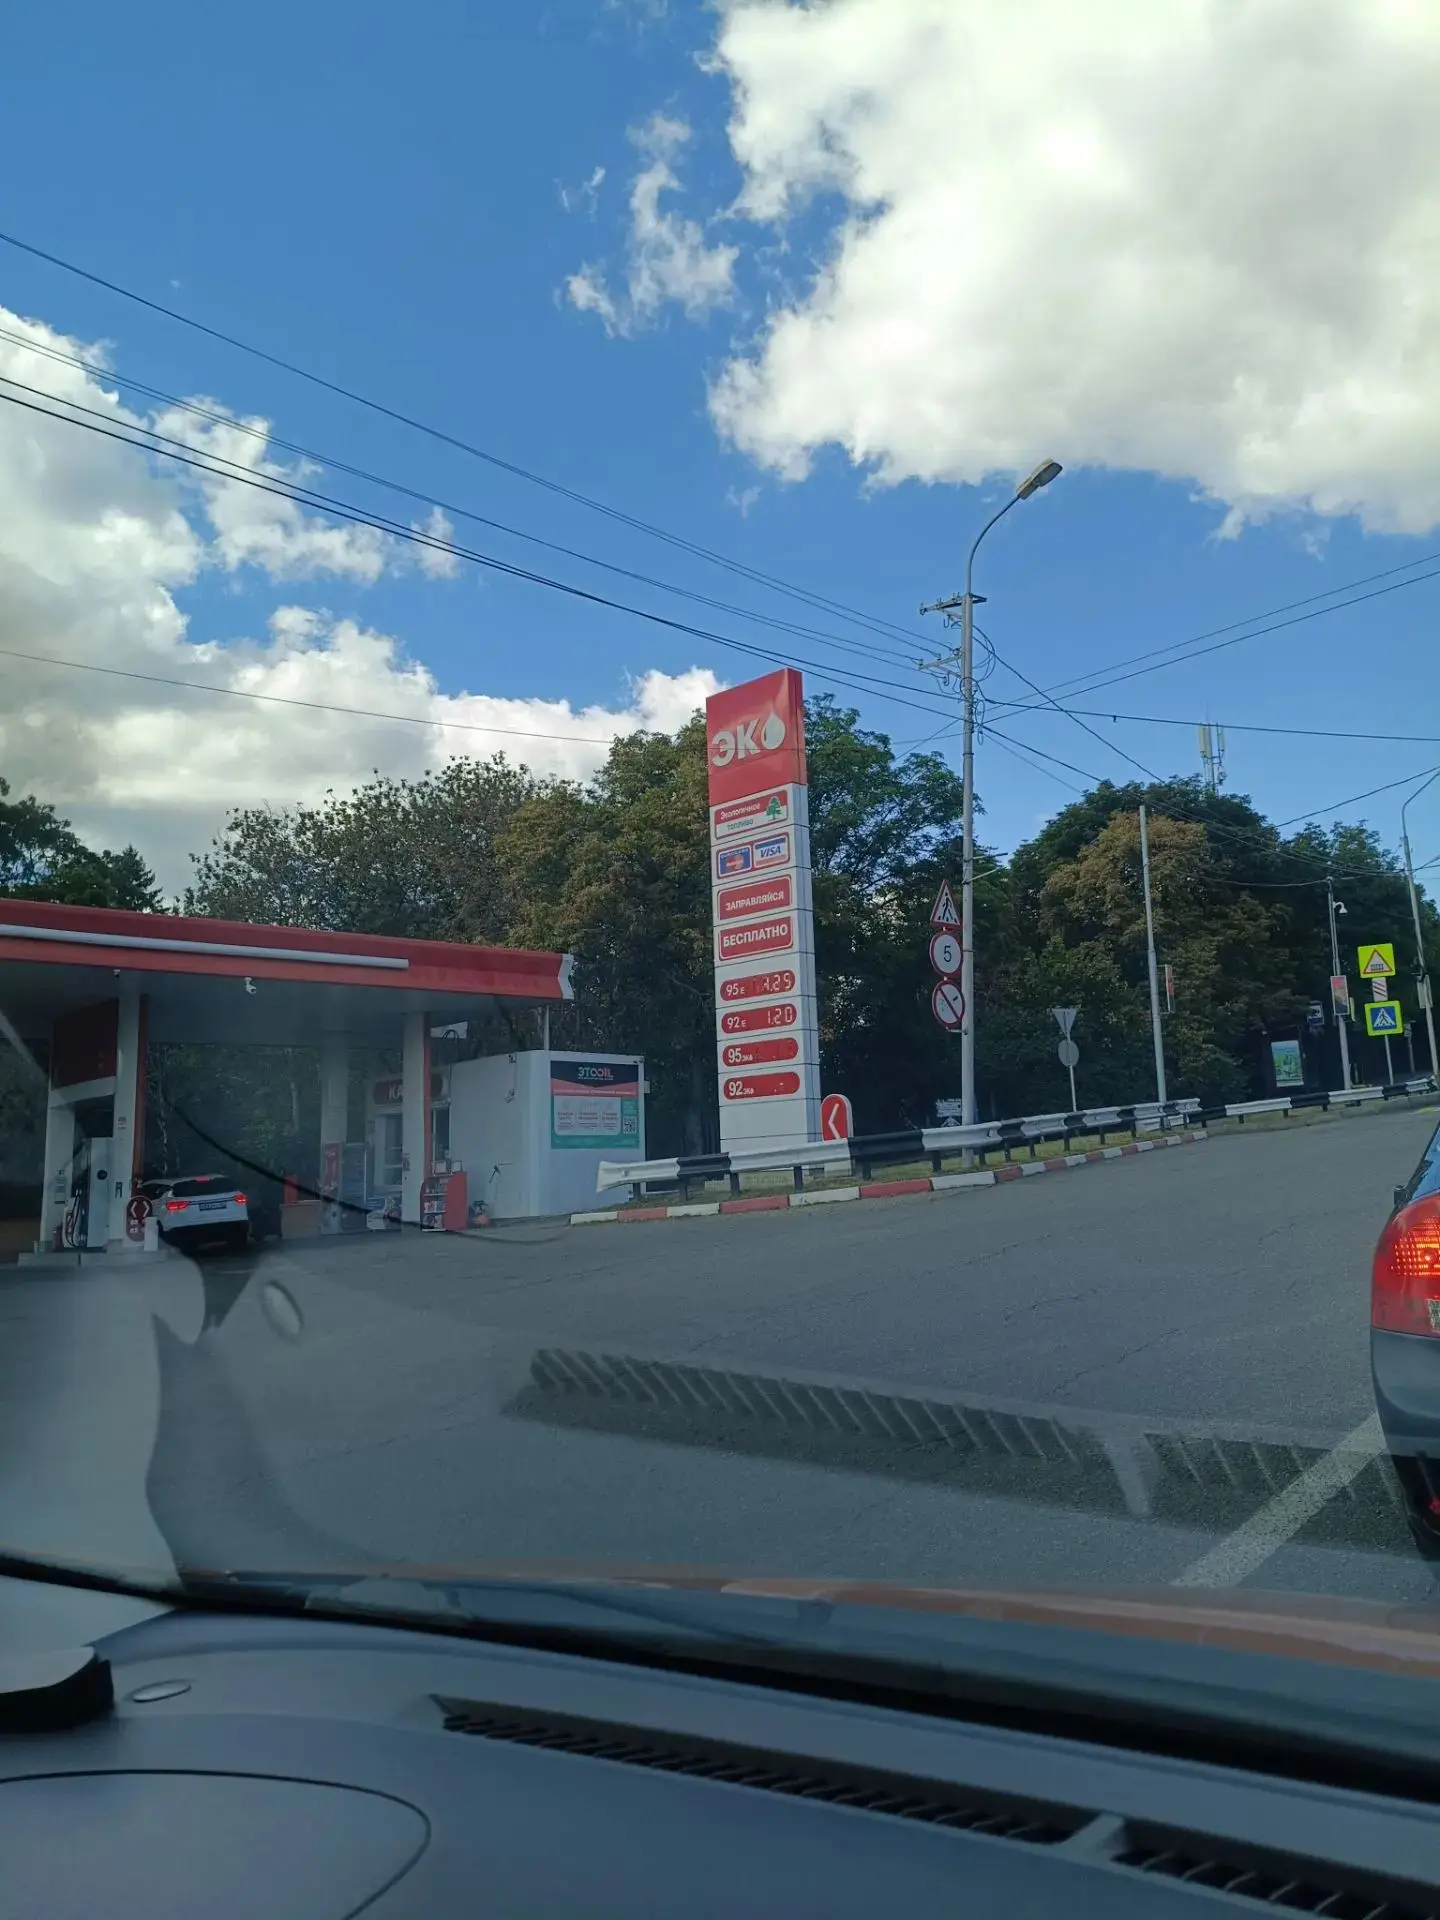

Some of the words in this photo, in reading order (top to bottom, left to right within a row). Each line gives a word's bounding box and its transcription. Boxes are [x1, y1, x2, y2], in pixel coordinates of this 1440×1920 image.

[760, 846, 781, 858] VISA
[726, 891, 784, 910] ЗАПРАВЛЯЙСЯ
[723, 924, 788, 947] БЕСПЛАТНО
[943, 945, 952, 963] 5
[726, 983, 739, 997] 95
[727, 1016, 740, 1030] 92
[767, 1006, 793, 1025] 1.20
